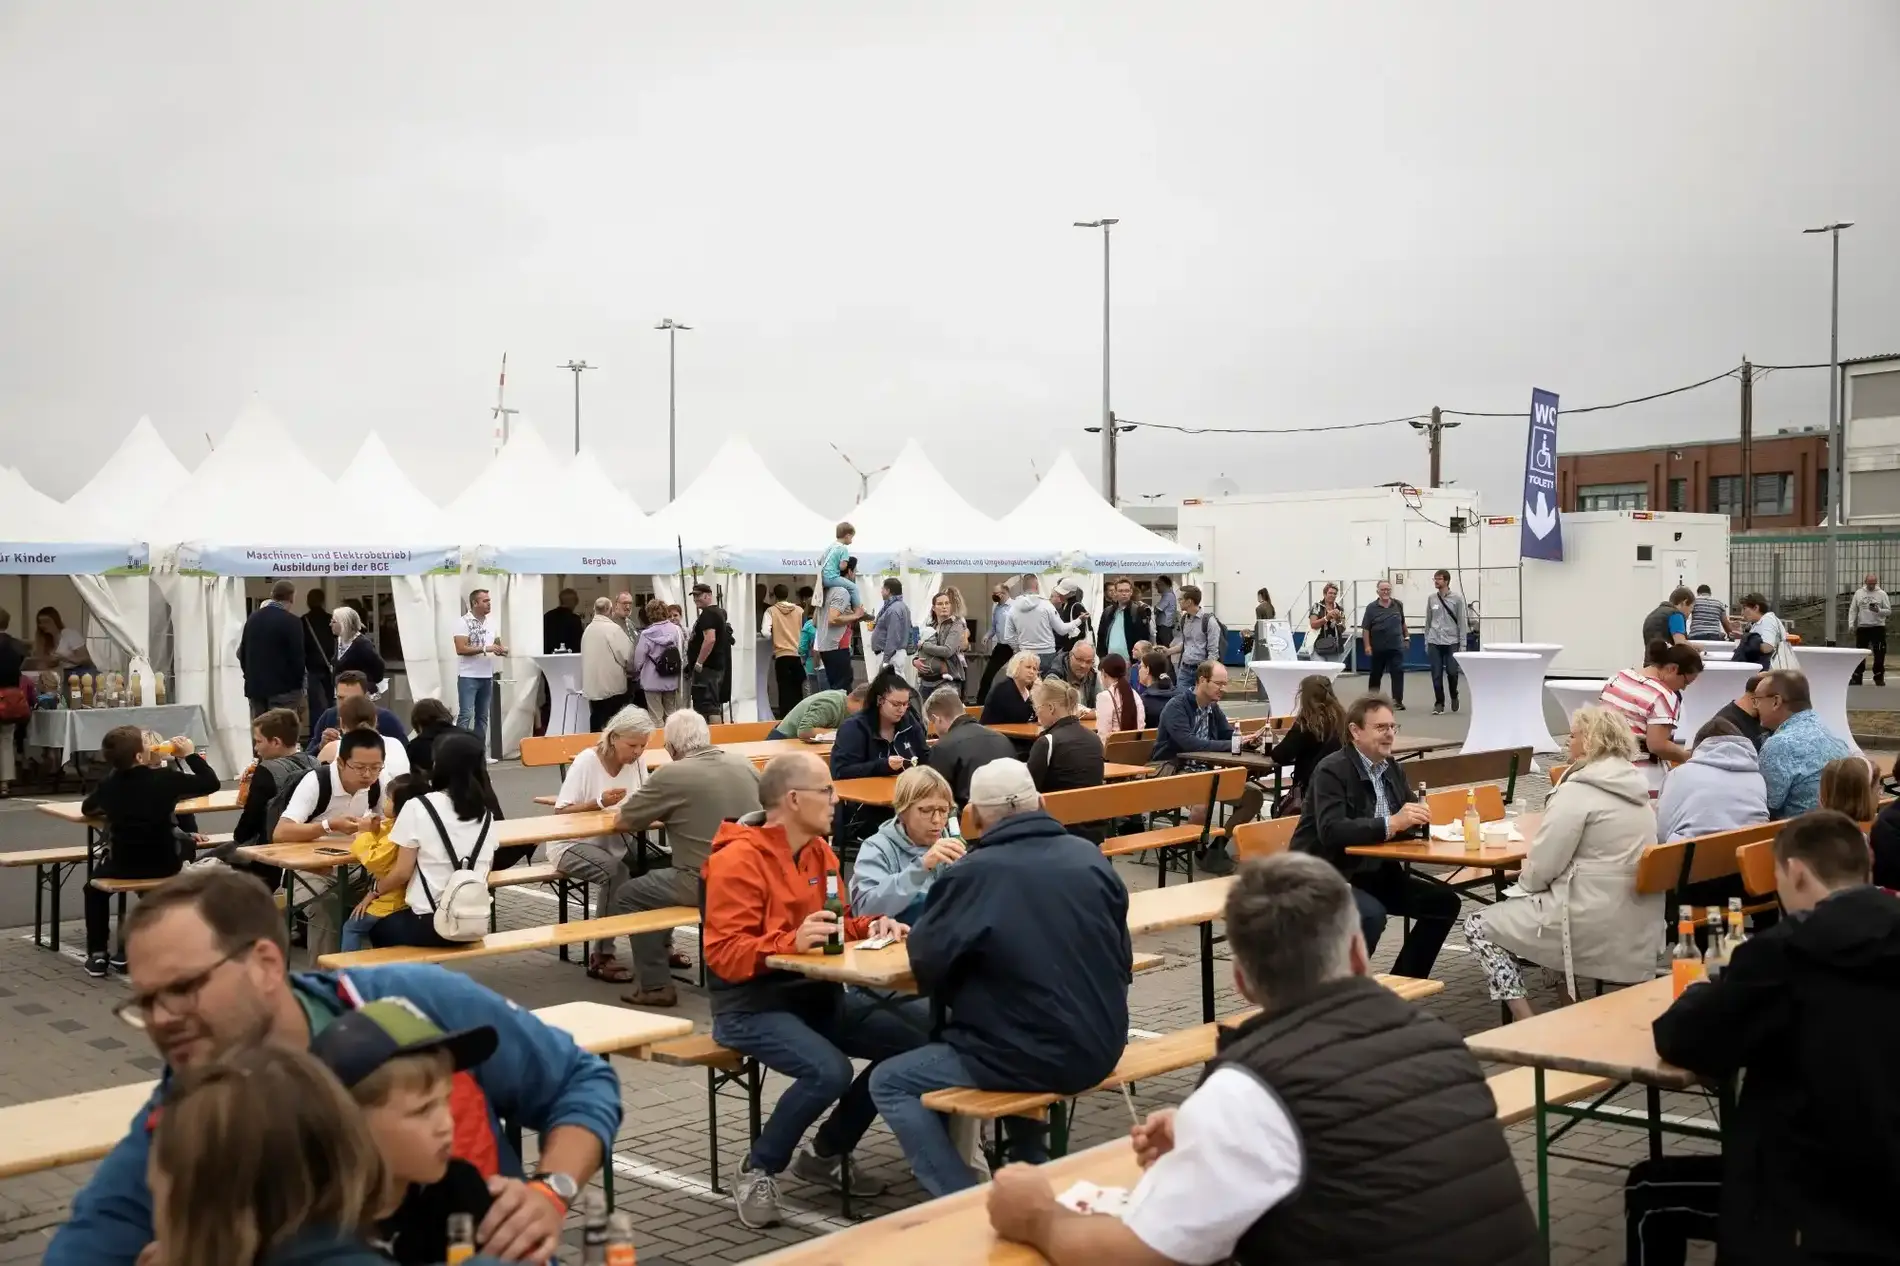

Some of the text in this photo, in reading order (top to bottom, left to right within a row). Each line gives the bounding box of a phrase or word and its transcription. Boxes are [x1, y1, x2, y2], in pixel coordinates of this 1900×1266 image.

[1534, 402, 1557, 427] WC
[14, 553, 56, 563] Kinder
[246, 551, 309, 560] Maschinen-
[311, 551, 331, 560] und
[333, 551, 406, 560] Elektrobetrieb
[582, 557, 617, 567] Bergbau
[1094, 559, 1117, 568] Geologie
[1675, 558, 1687, 568] WC
[272, 562, 389, 573] Ausbildung bei der BGE
